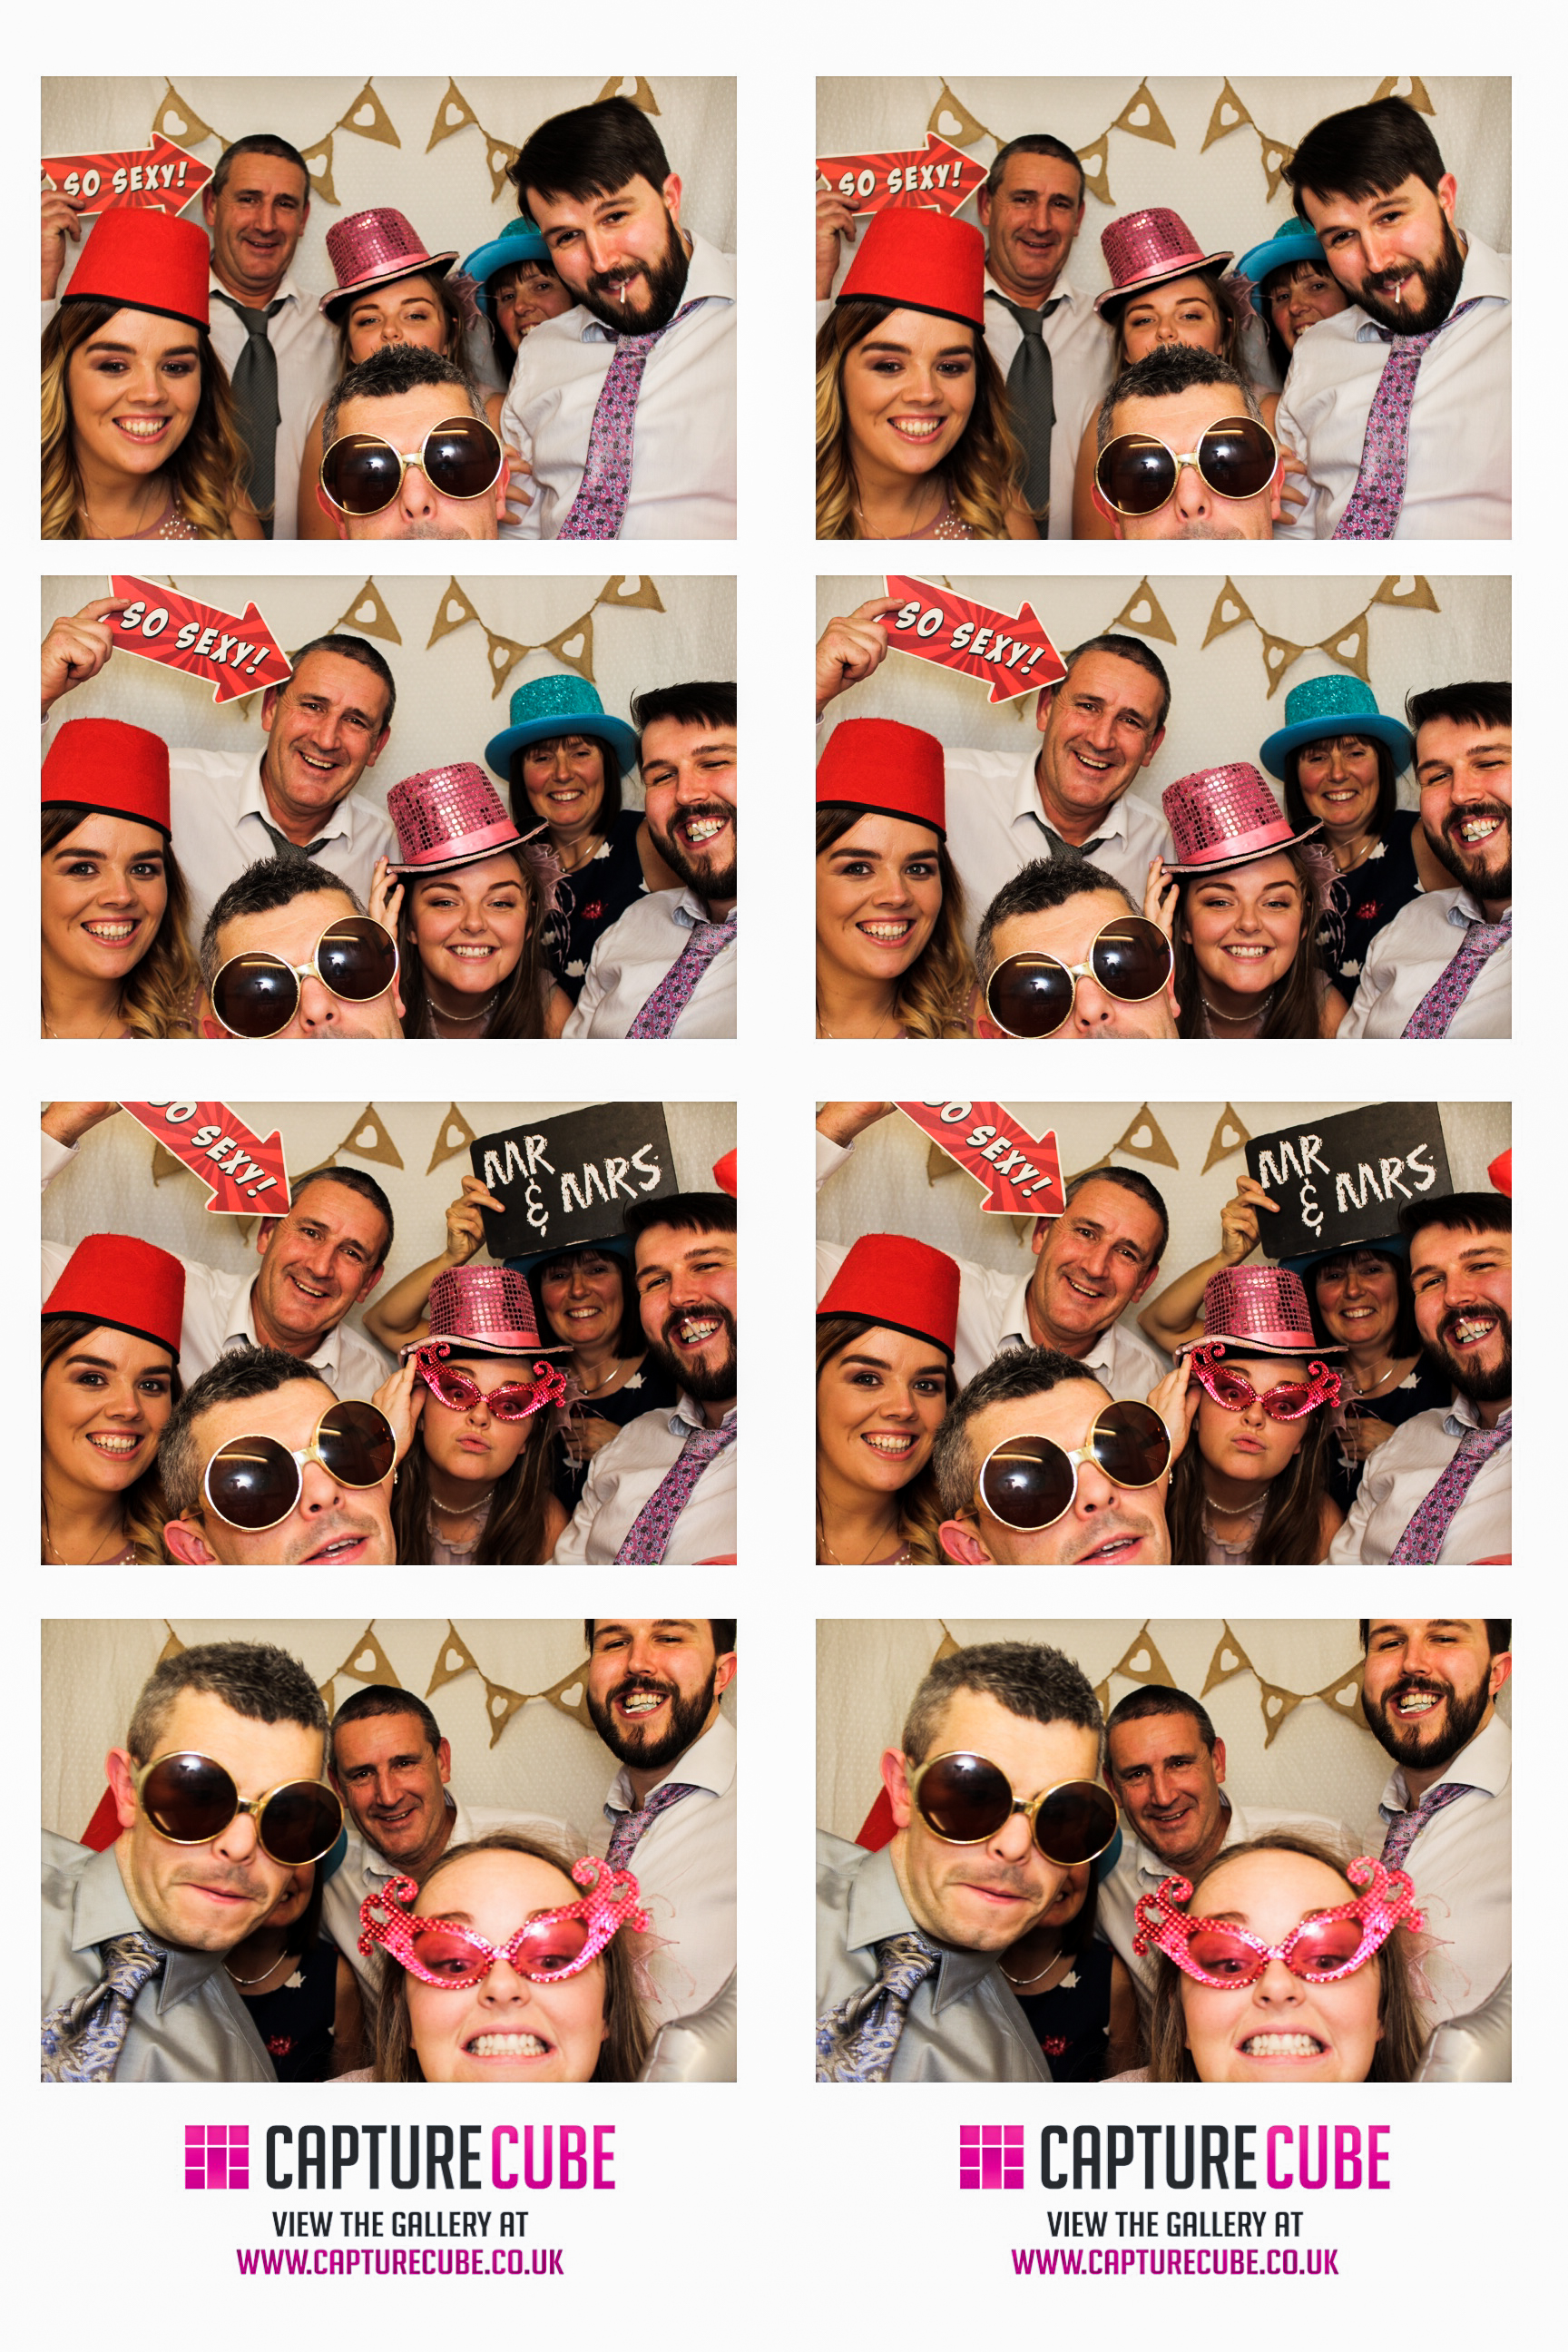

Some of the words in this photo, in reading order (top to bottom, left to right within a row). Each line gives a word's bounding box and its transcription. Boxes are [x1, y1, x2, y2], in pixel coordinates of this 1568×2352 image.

[63, 170, 101, 198] SO
[112, 161, 189, 194] SEXY!
[838, 170, 876, 198] SO
[887, 161, 964, 194] SEXY!
[120, 600, 170, 639] SO
[174, 622, 271, 675] SEXY!
[895, 600, 945, 639] SO
[949, 622, 1046, 675] SEXY!
[148, 1102, 198, 1124] O
[190, 1125, 278, 1198] SEXY!
[484, 1134, 555, 1189] MR
[923, 1102, 973, 1124] O
[965, 1125, 1053, 1198] SEXY!
[1259, 1134, 1330, 1189] MR
[524, 1178, 549, 1238] &
[560, 1142, 662, 1213] MRS
[1299, 1178, 1324, 1238] &
[1335, 1142, 1437, 1213] MRS
